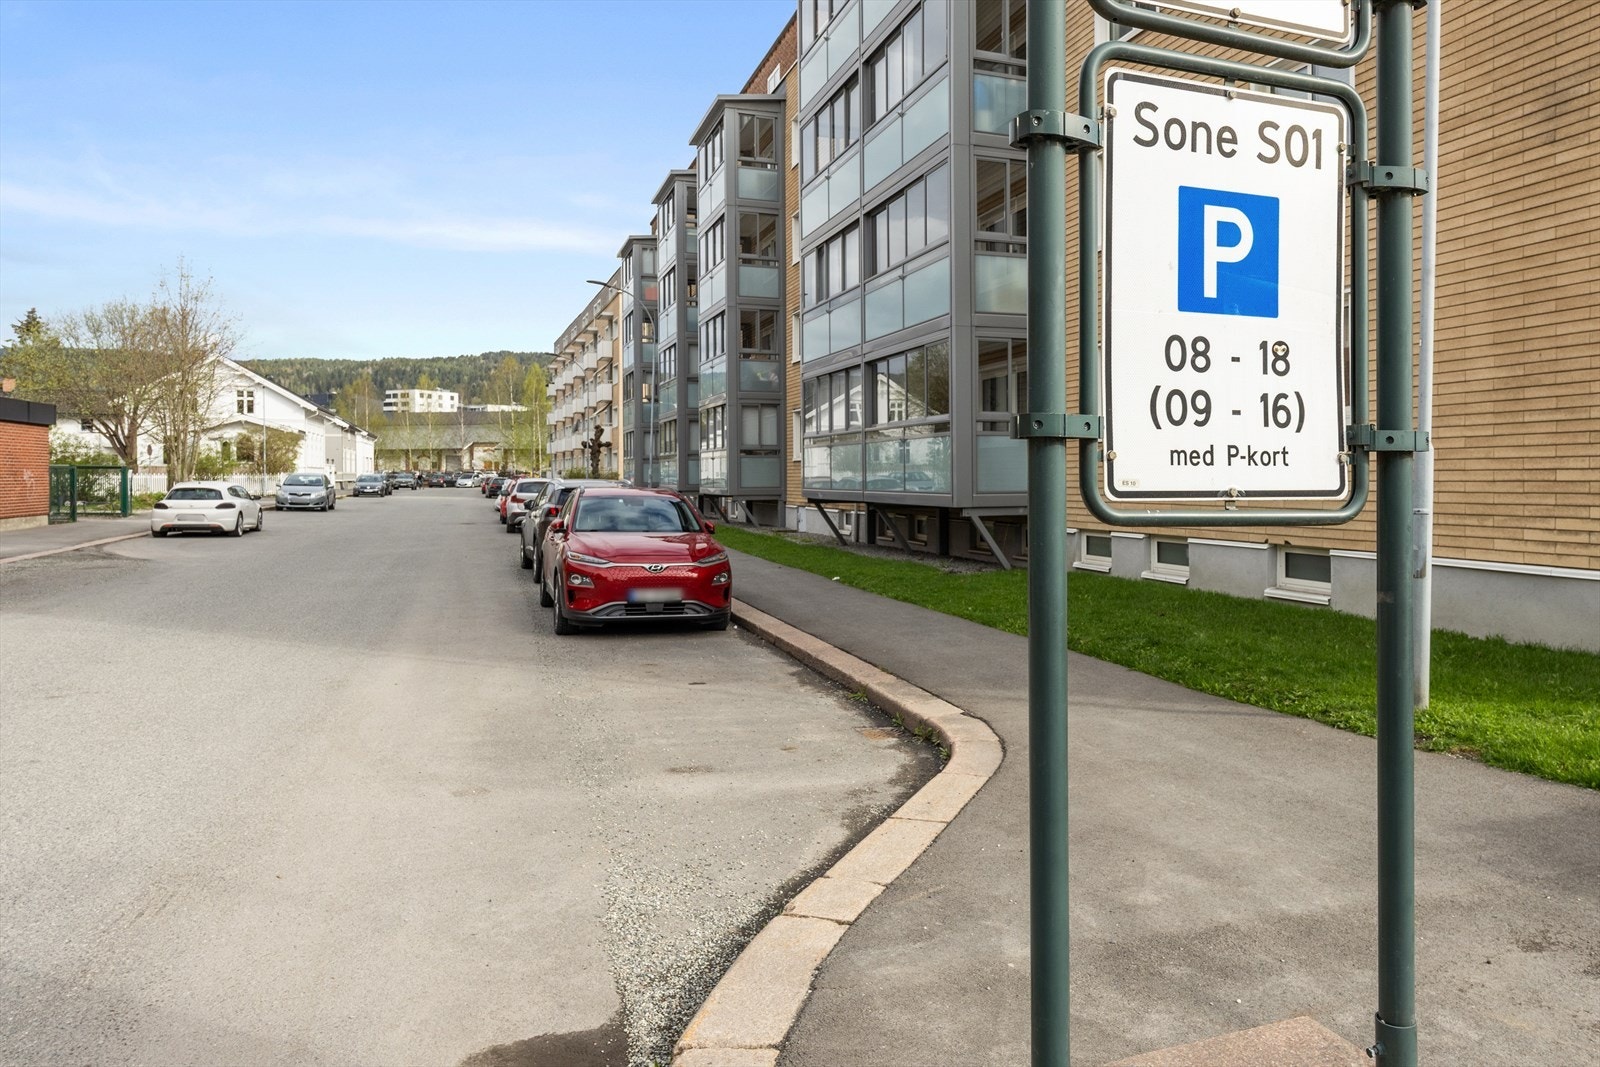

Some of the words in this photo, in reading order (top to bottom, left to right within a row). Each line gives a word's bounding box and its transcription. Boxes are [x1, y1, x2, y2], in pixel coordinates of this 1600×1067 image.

[1133, 101, 1239, 159] Sone
[1256, 120, 1322, 170] S01
[1203, 204, 1254, 299] P
[1164, 334, 1211, 374] 08
[1259, 340, 1291, 377] 18
[1149, 385, 1212, 430] (09
[1259, 391, 1306, 435] 16)
[1170, 444, 1215, 467] med
[1227, 444, 1289, 467] P-kort
